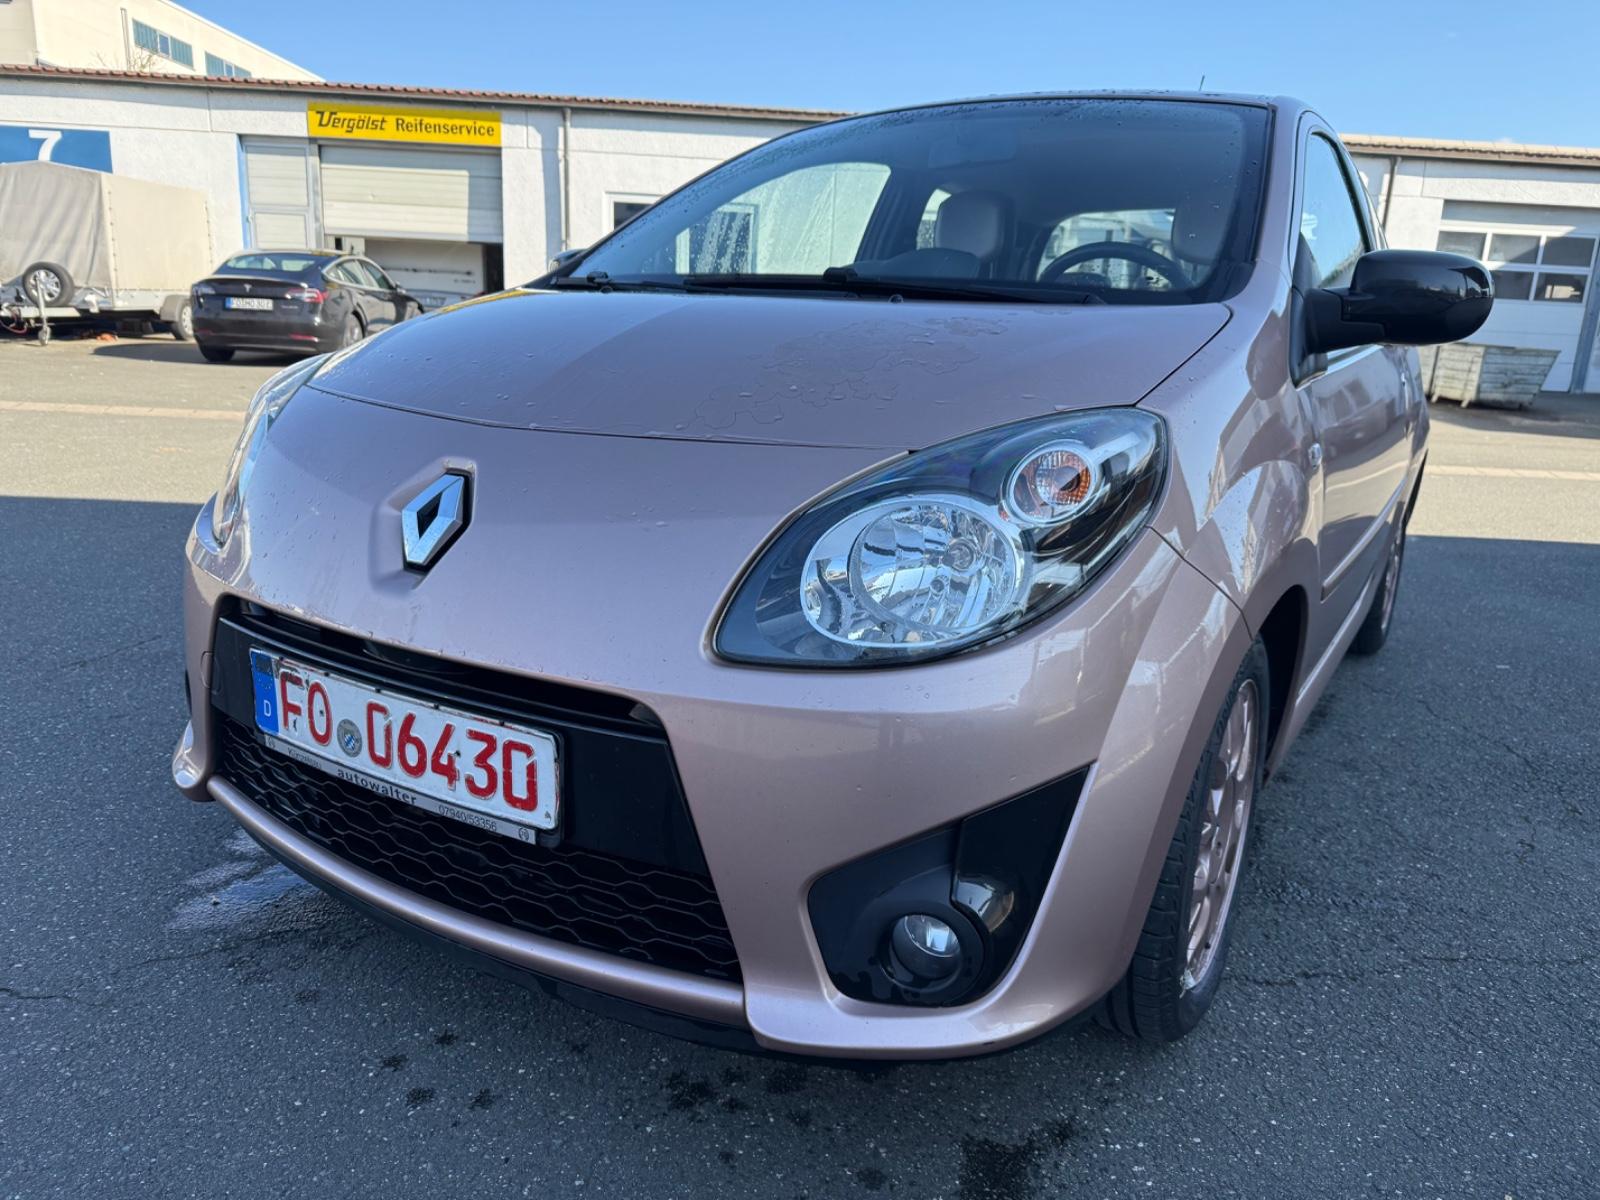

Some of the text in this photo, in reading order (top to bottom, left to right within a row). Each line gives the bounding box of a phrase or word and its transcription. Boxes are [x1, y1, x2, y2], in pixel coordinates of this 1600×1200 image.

[316, 111, 495, 137] Vergölst Reifenservice
[28, 129, 62, 161] 7
[263, 699, 272, 717] D
[366, 699, 538, 812] 06430
[337, 768, 417, 805] autowalter
